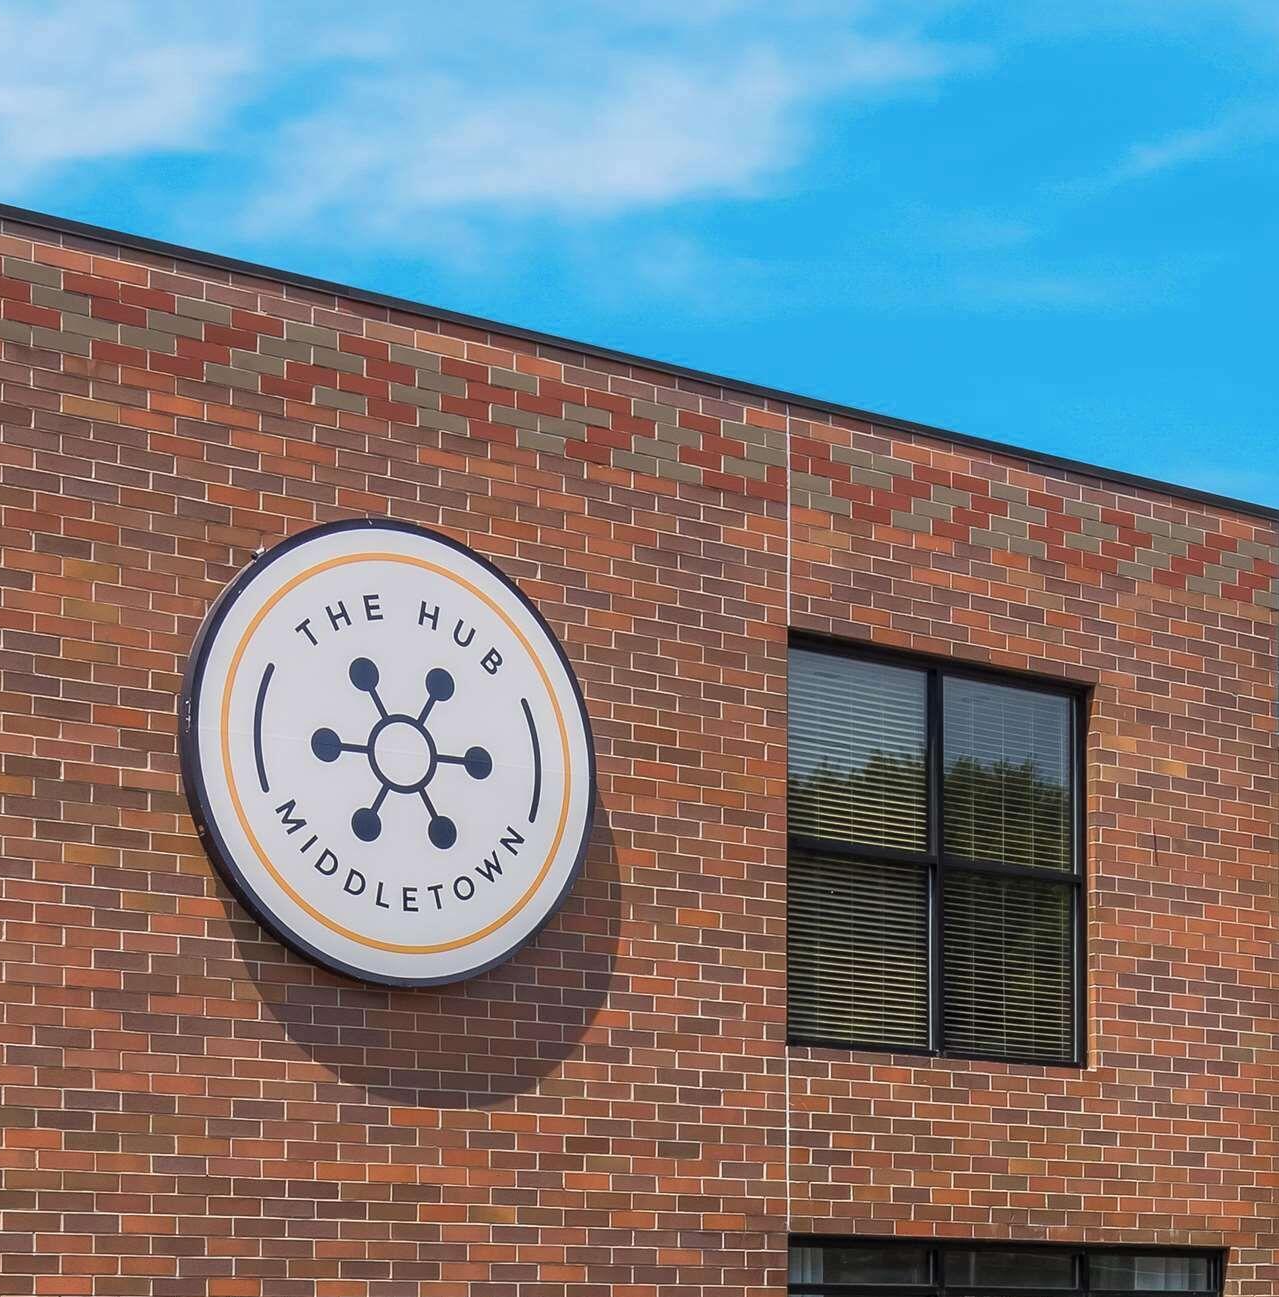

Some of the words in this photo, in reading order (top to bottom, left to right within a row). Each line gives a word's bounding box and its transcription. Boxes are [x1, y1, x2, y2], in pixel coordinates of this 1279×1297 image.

[294, 594, 384, 648] THE
[419, 600, 504, 675] HUB
[275, 798, 526, 912] MIDDLETOWN
